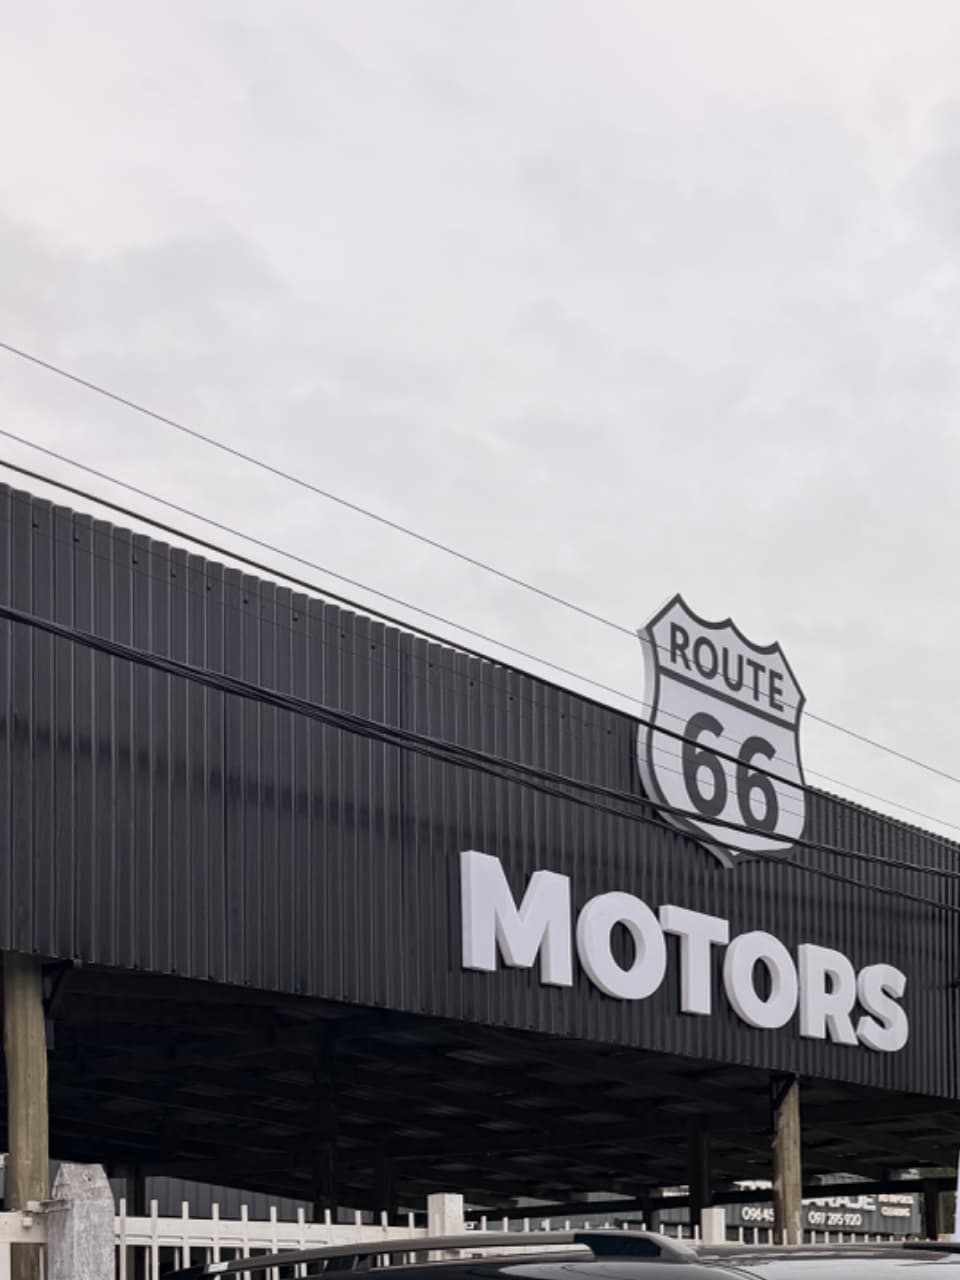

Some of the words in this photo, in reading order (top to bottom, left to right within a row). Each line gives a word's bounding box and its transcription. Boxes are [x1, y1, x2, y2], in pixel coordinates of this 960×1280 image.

[668, 620, 785, 713] ROUTE
[681, 711, 780, 834] 66
[460, 849, 909, 1052] MOTORS
